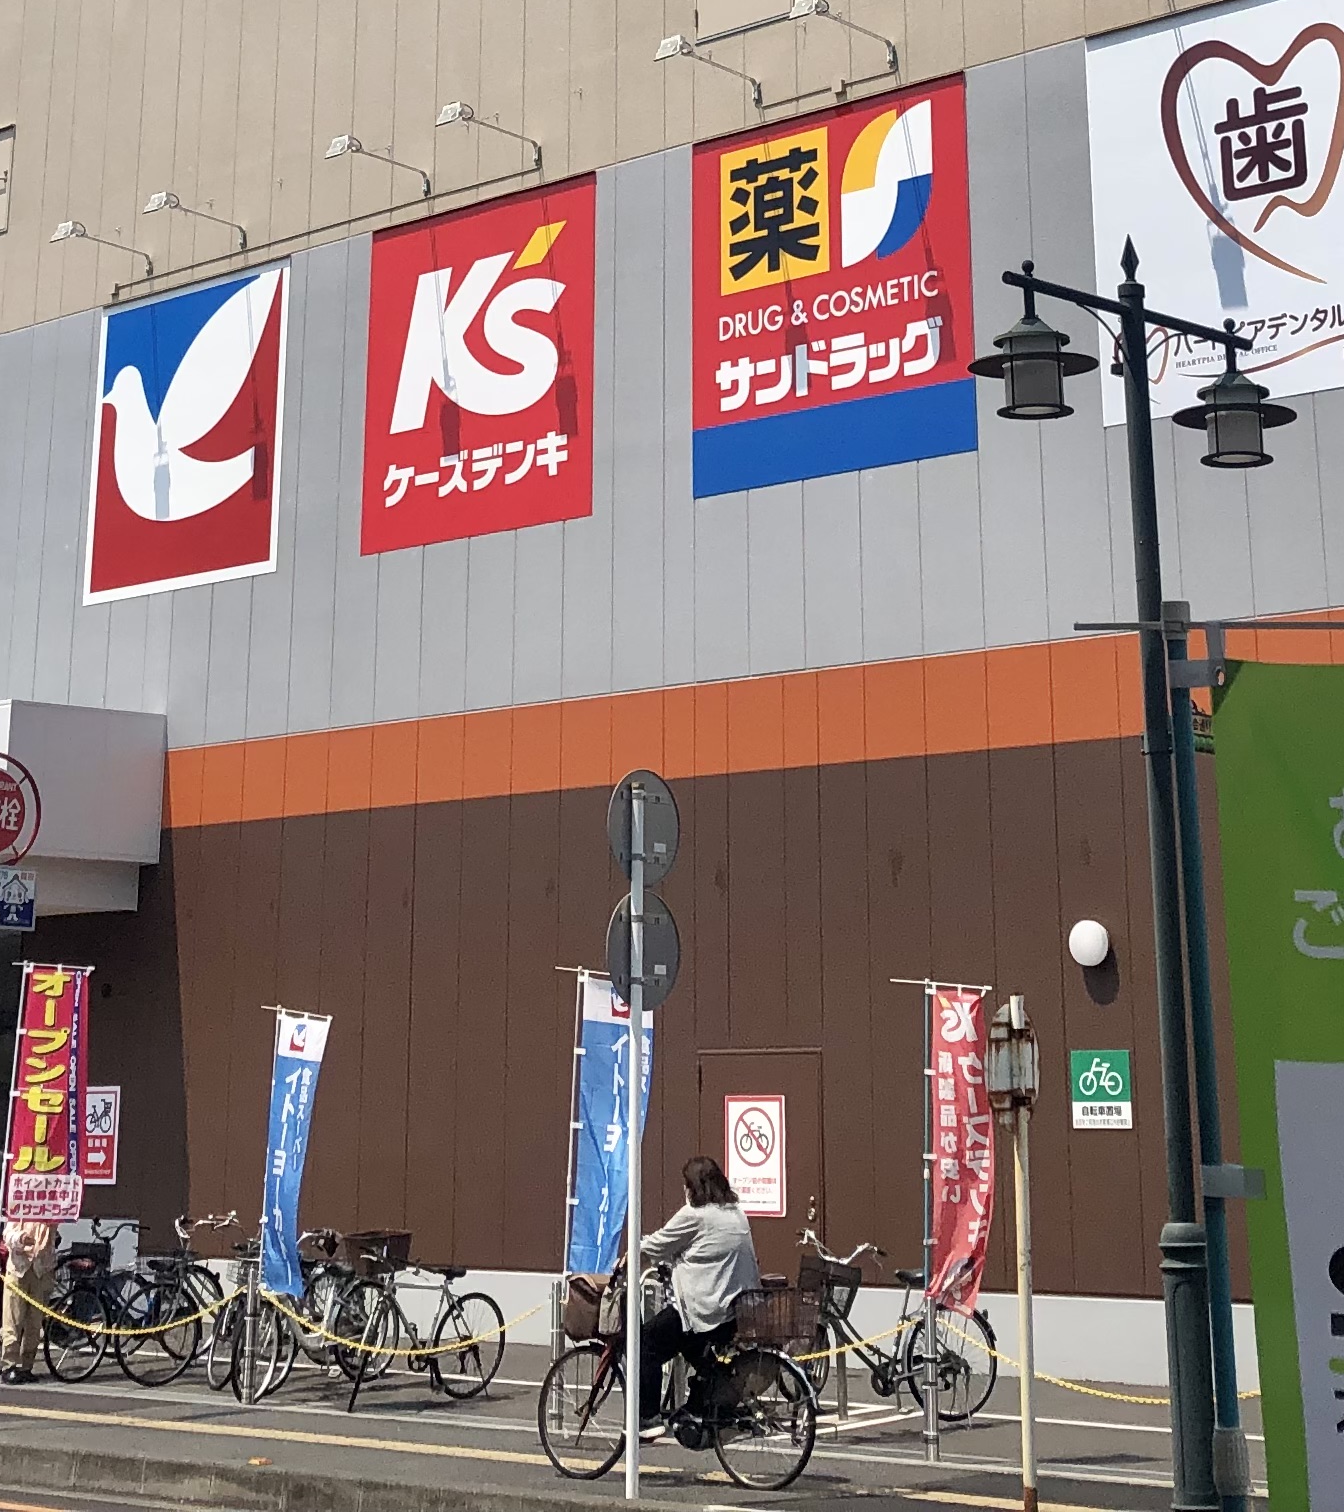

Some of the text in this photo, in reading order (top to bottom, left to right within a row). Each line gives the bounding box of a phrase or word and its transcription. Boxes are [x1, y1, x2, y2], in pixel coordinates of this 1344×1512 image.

[1213, 85, 1309, 202] 歯
[728, 145, 821, 282] 薬
[389, 219, 568, 436] K's
[717, 270, 939, 342] DRUG & COSMETIC
[715, 315, 943, 413] サンドラッグ
[383, 430, 569, 508] ケーズデンキ
[12, 971, 71, 1173] オープンセール
[13, 1175, 80, 1190] ポイントカード
